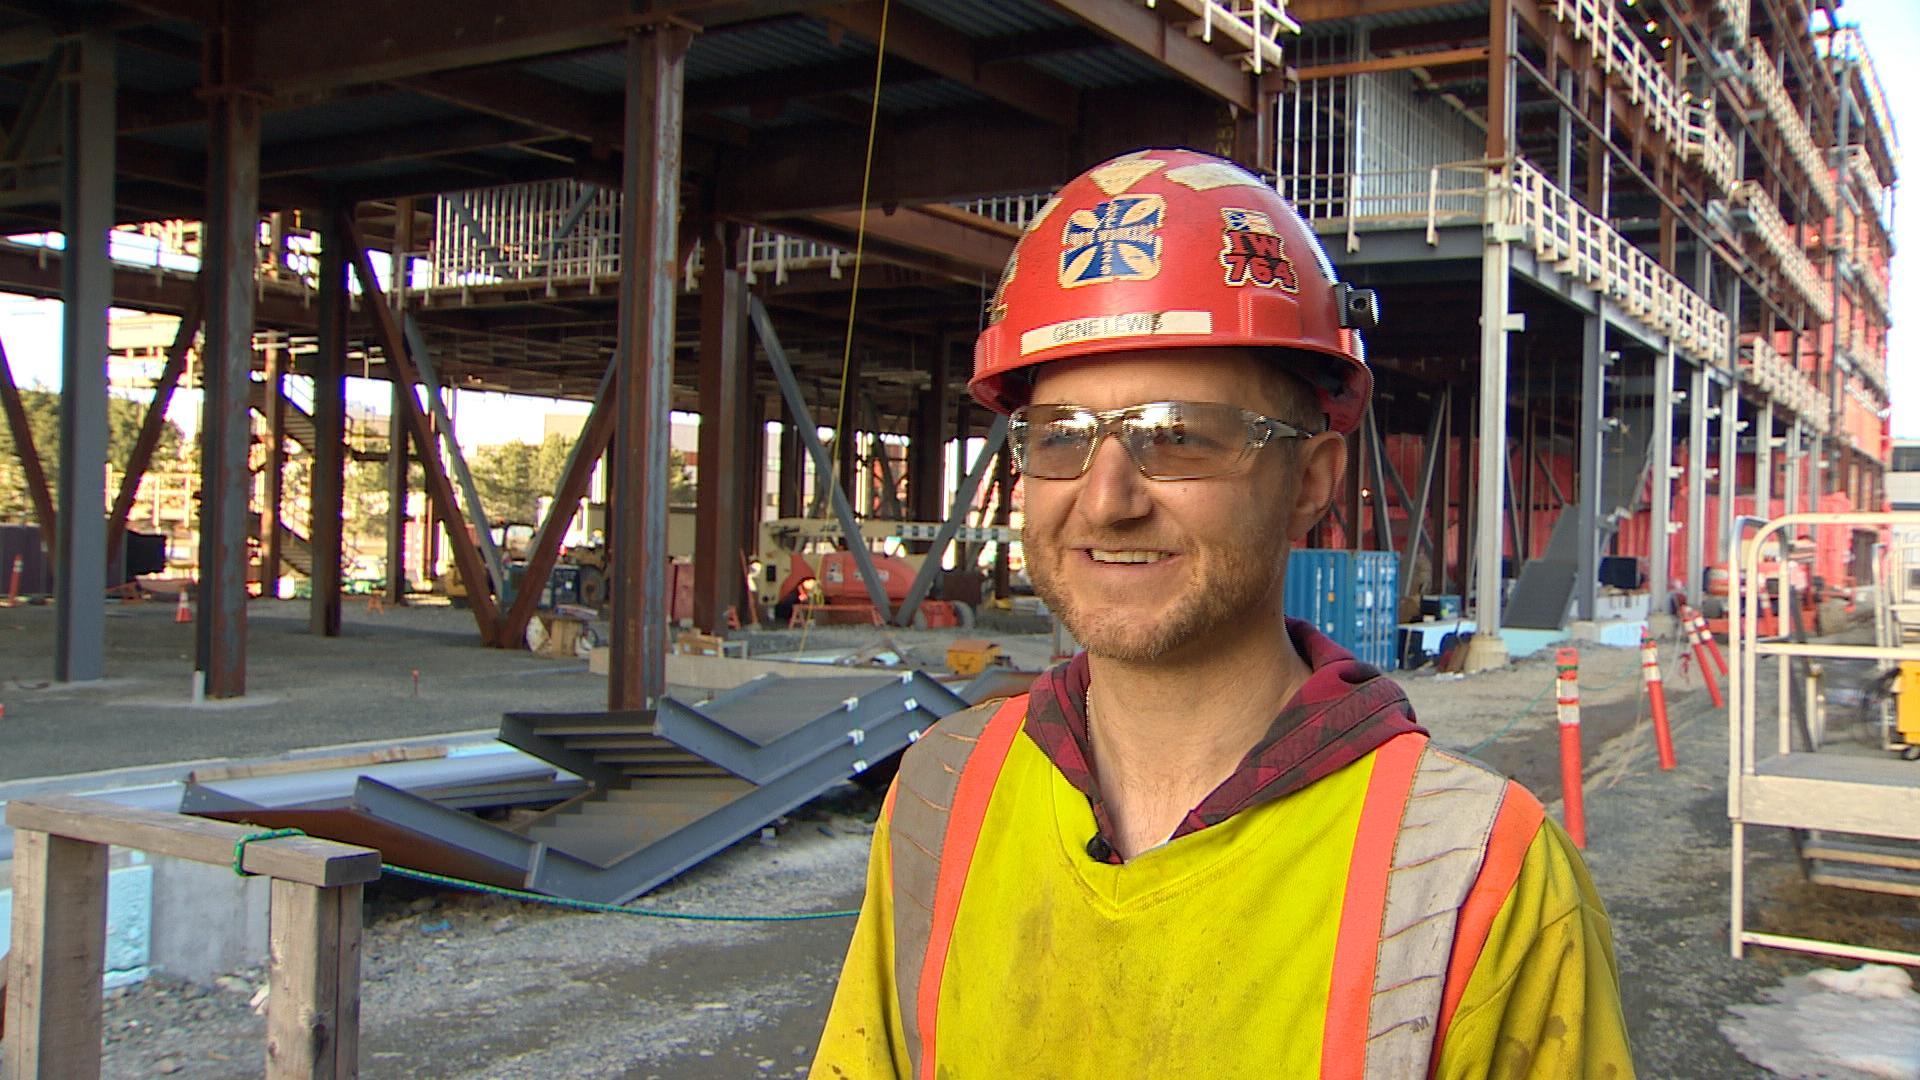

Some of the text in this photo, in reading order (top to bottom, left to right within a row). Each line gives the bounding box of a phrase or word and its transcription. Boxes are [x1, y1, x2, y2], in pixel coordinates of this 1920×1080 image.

[1099, 223, 1155, 245] WORKERS
[1227, 230, 1282, 260] IW
[1226, 254, 1296, 291] 764
[1053, 319, 1100, 343] GENE
